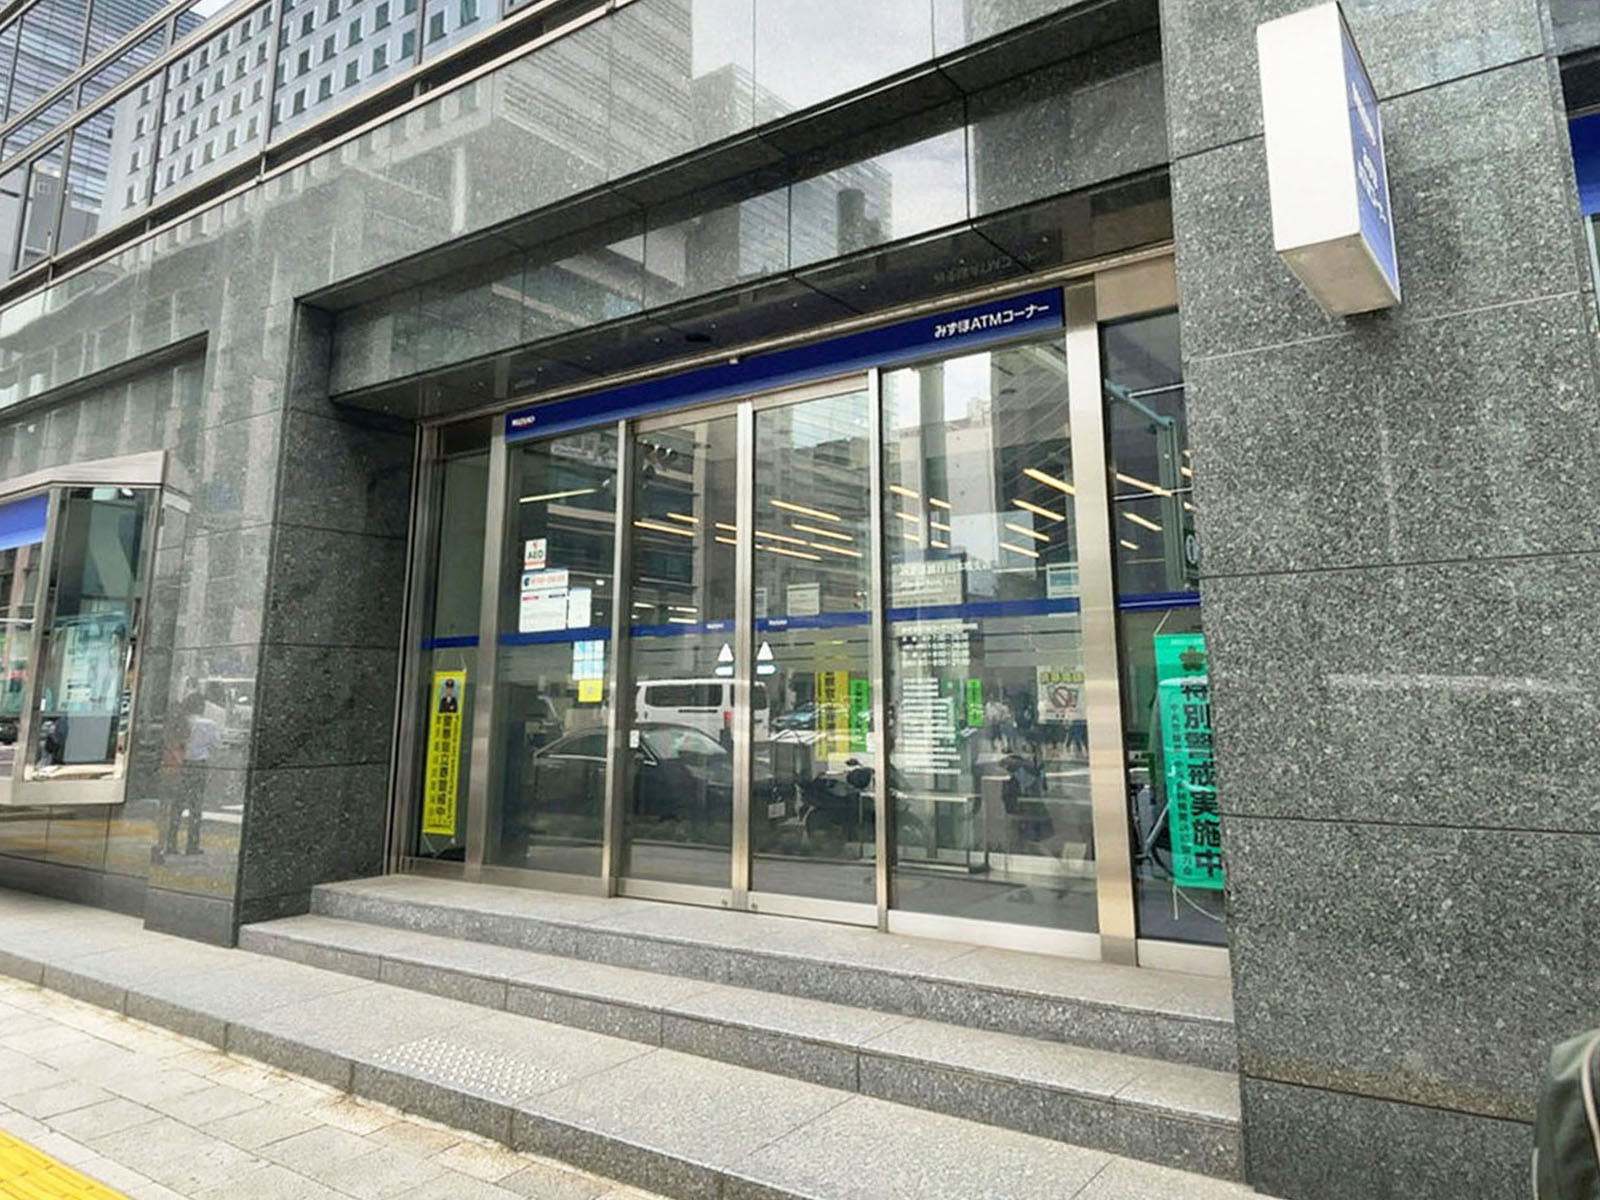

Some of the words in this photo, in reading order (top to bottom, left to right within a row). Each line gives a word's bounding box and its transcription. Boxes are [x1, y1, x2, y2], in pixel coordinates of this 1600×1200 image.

[934, 304, 1050, 338] みずほATMコーナー
[527, 549, 544, 559] AED
